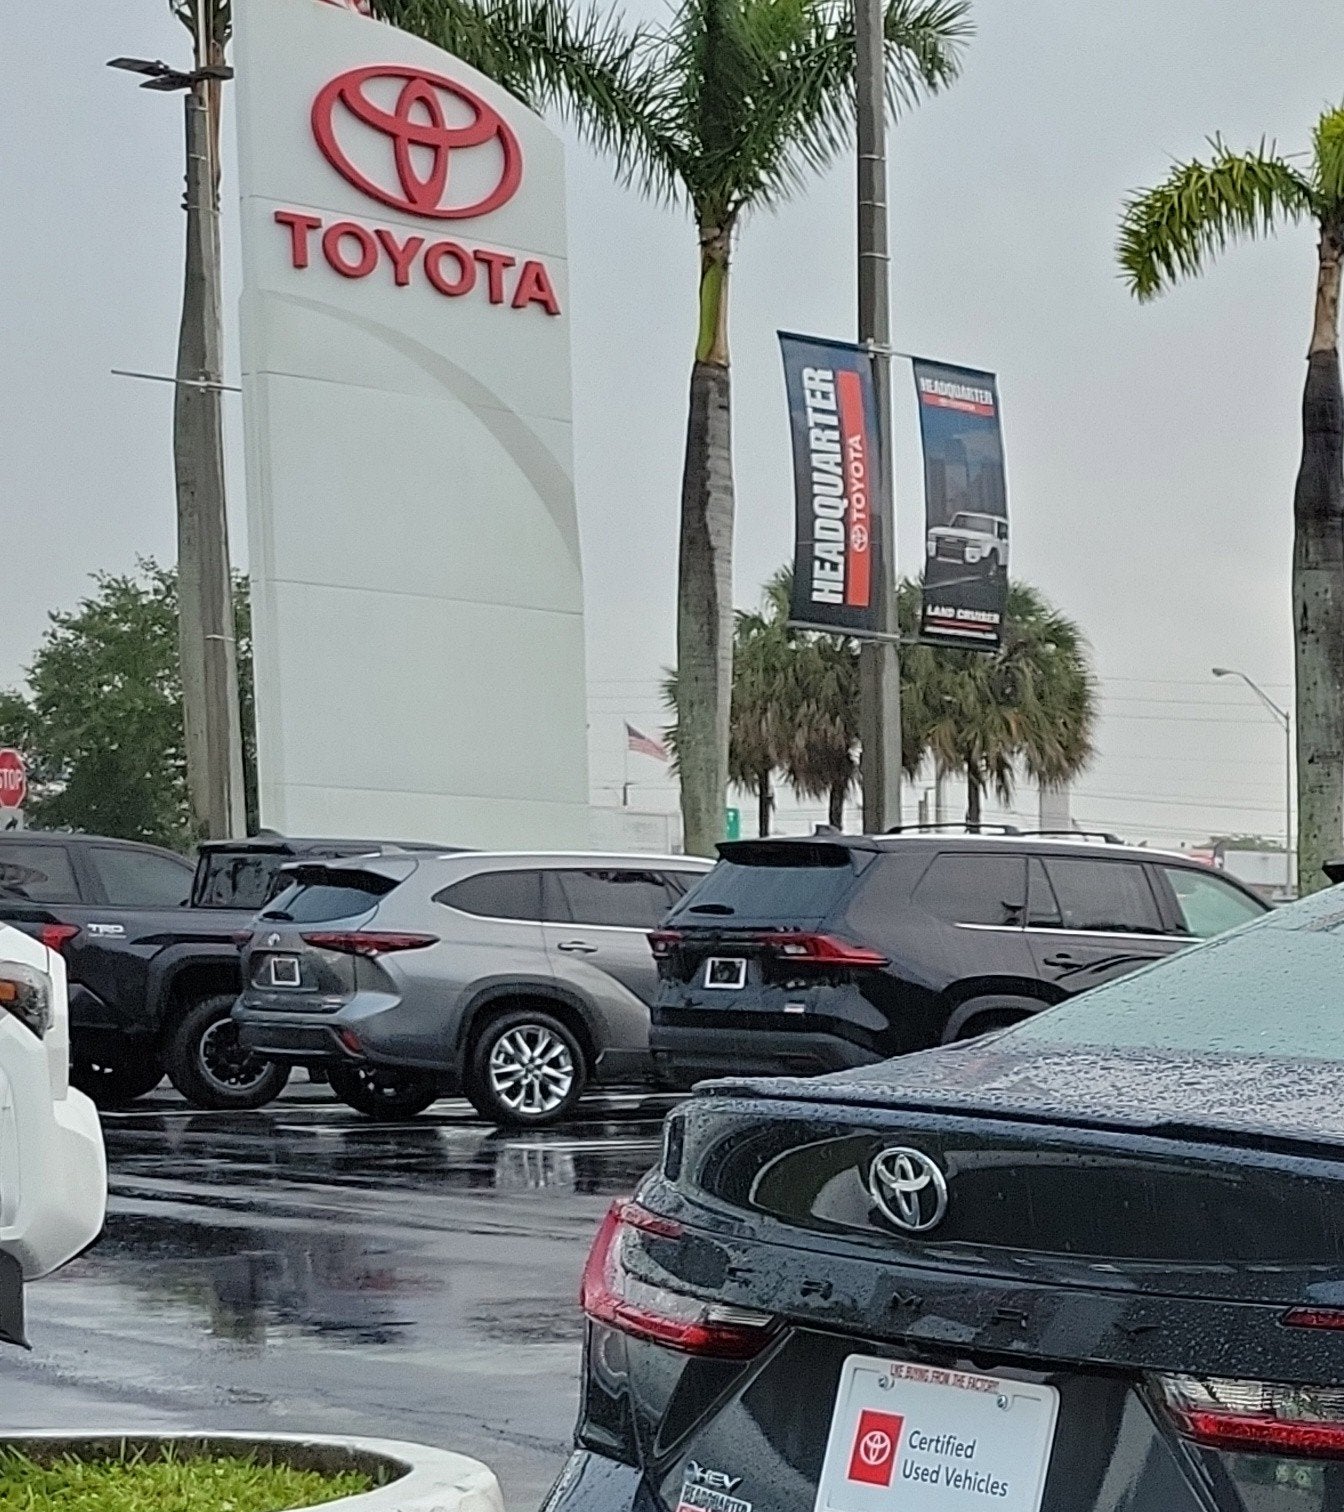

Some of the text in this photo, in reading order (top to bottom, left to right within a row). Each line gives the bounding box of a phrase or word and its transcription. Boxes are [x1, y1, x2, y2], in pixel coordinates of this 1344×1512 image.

[274, 210, 561, 316] TOYOTA
[803, 367, 848, 604] HEADQUARTER
[849, 434, 867, 521] TOYOTA
[902, 1458, 1009, 1497] Used Vehicles
[908, 1430, 976, 1459] Certified
